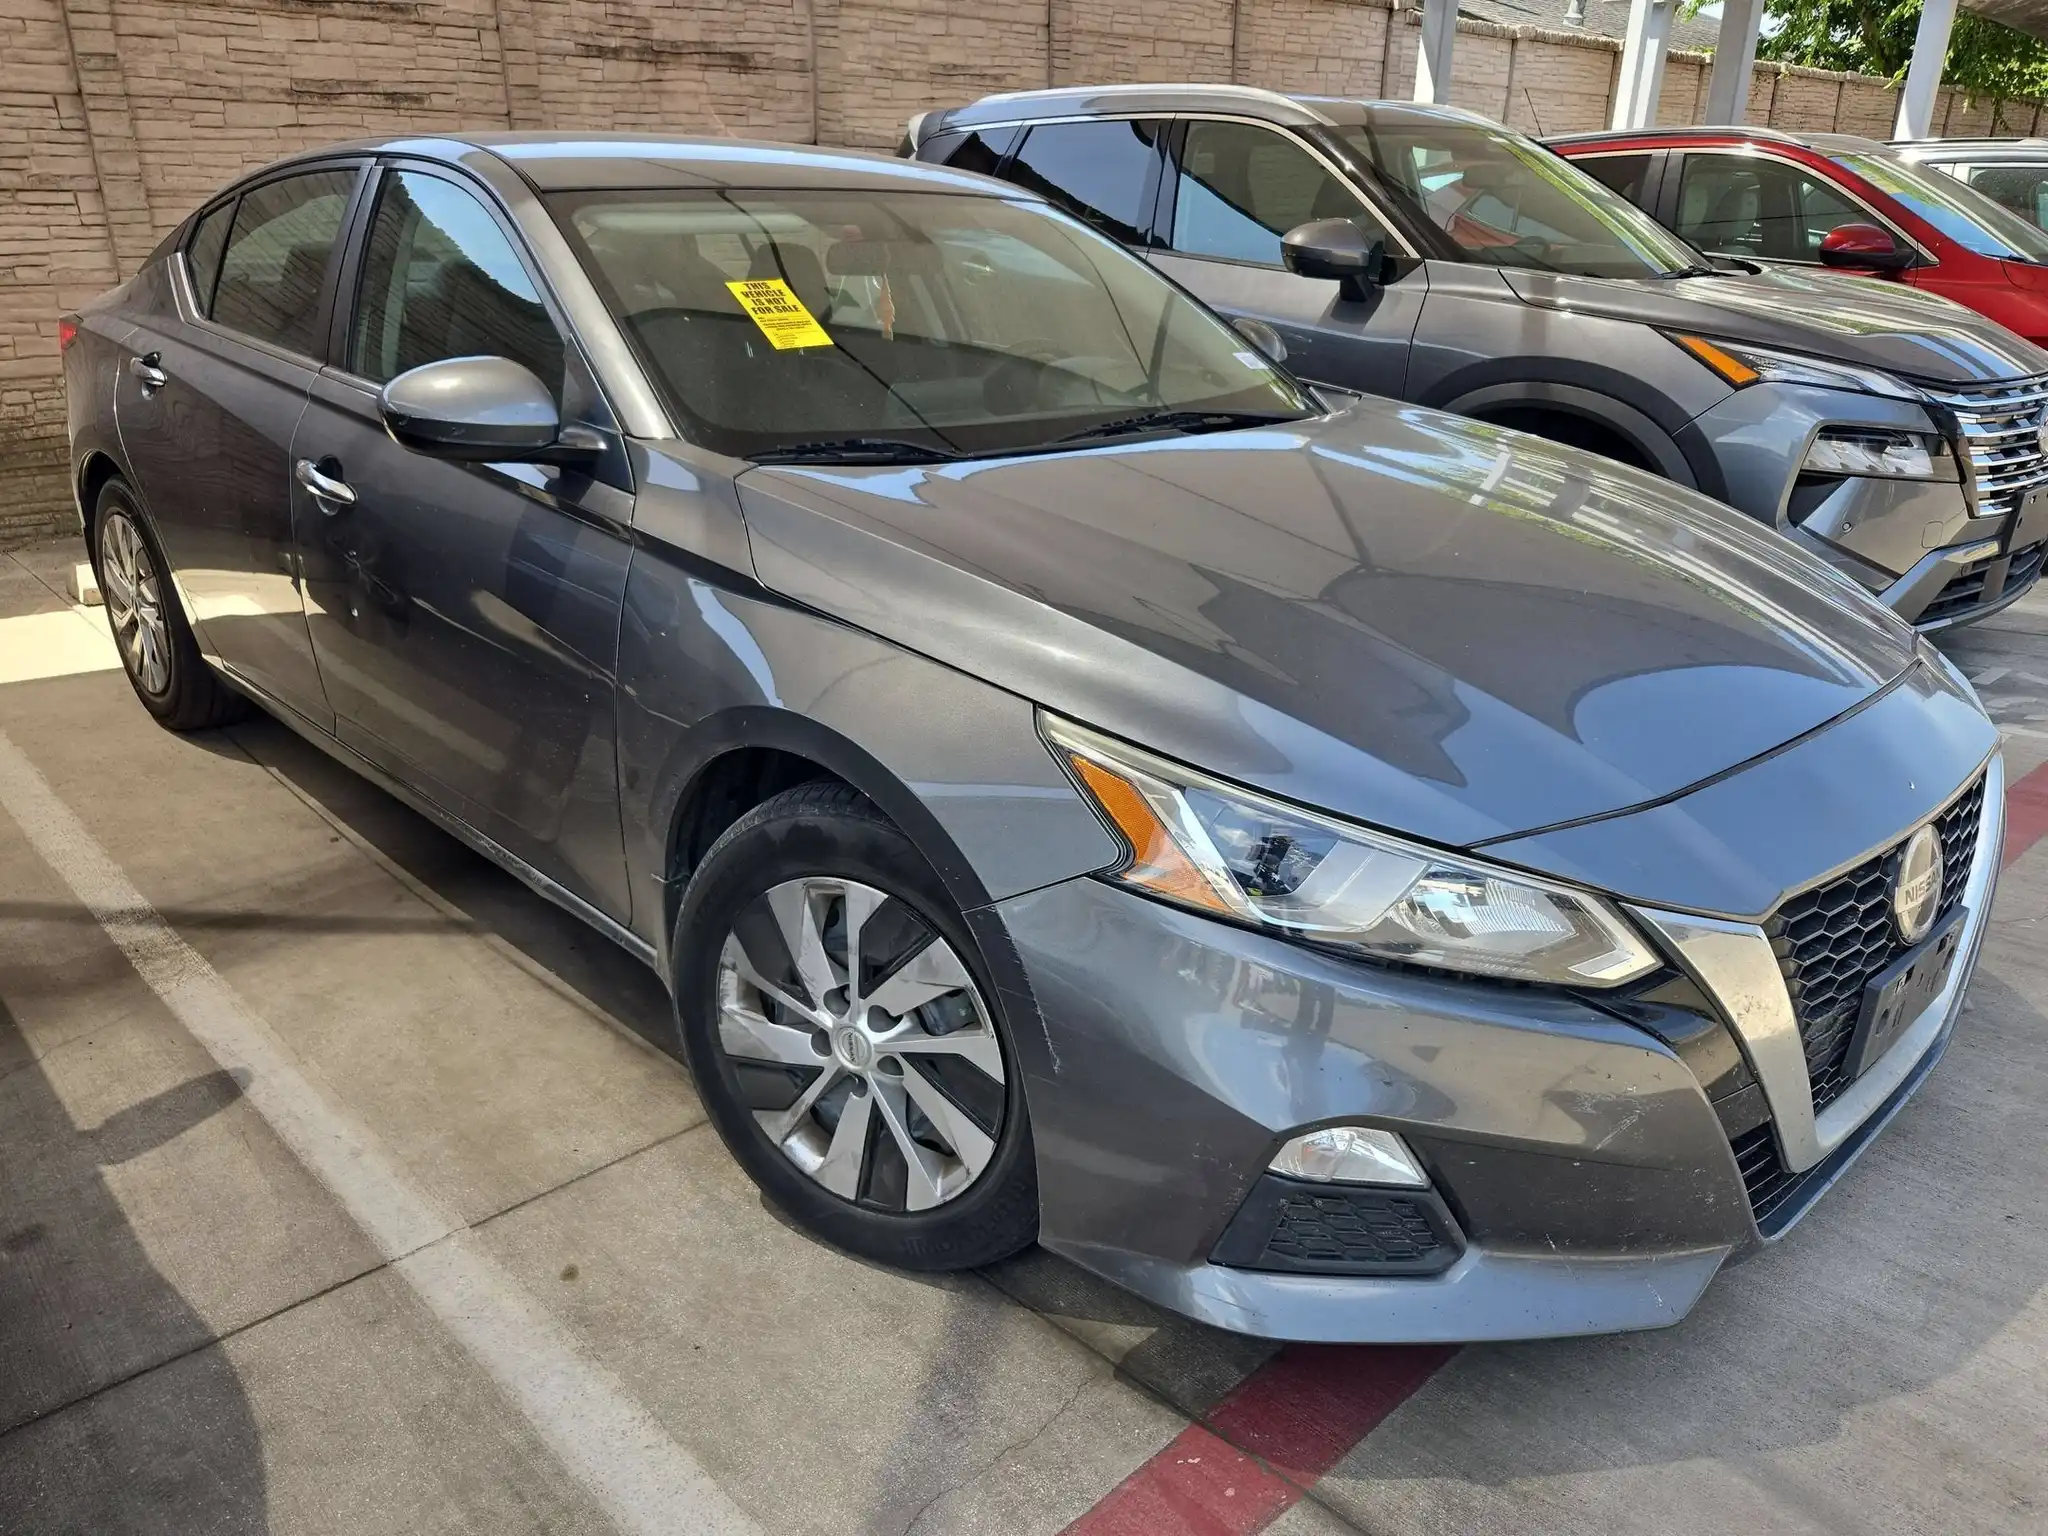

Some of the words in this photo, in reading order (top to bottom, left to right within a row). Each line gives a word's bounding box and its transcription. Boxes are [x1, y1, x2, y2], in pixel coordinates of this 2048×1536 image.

[743, 282, 771, 290] THIS
[740, 289, 786, 298] VEHICLE
[751, 298, 765, 306] IS
[765, 297, 787, 306] NOT
[751, 306, 775, 314] FOR
[774, 304, 801, 313] SALE
